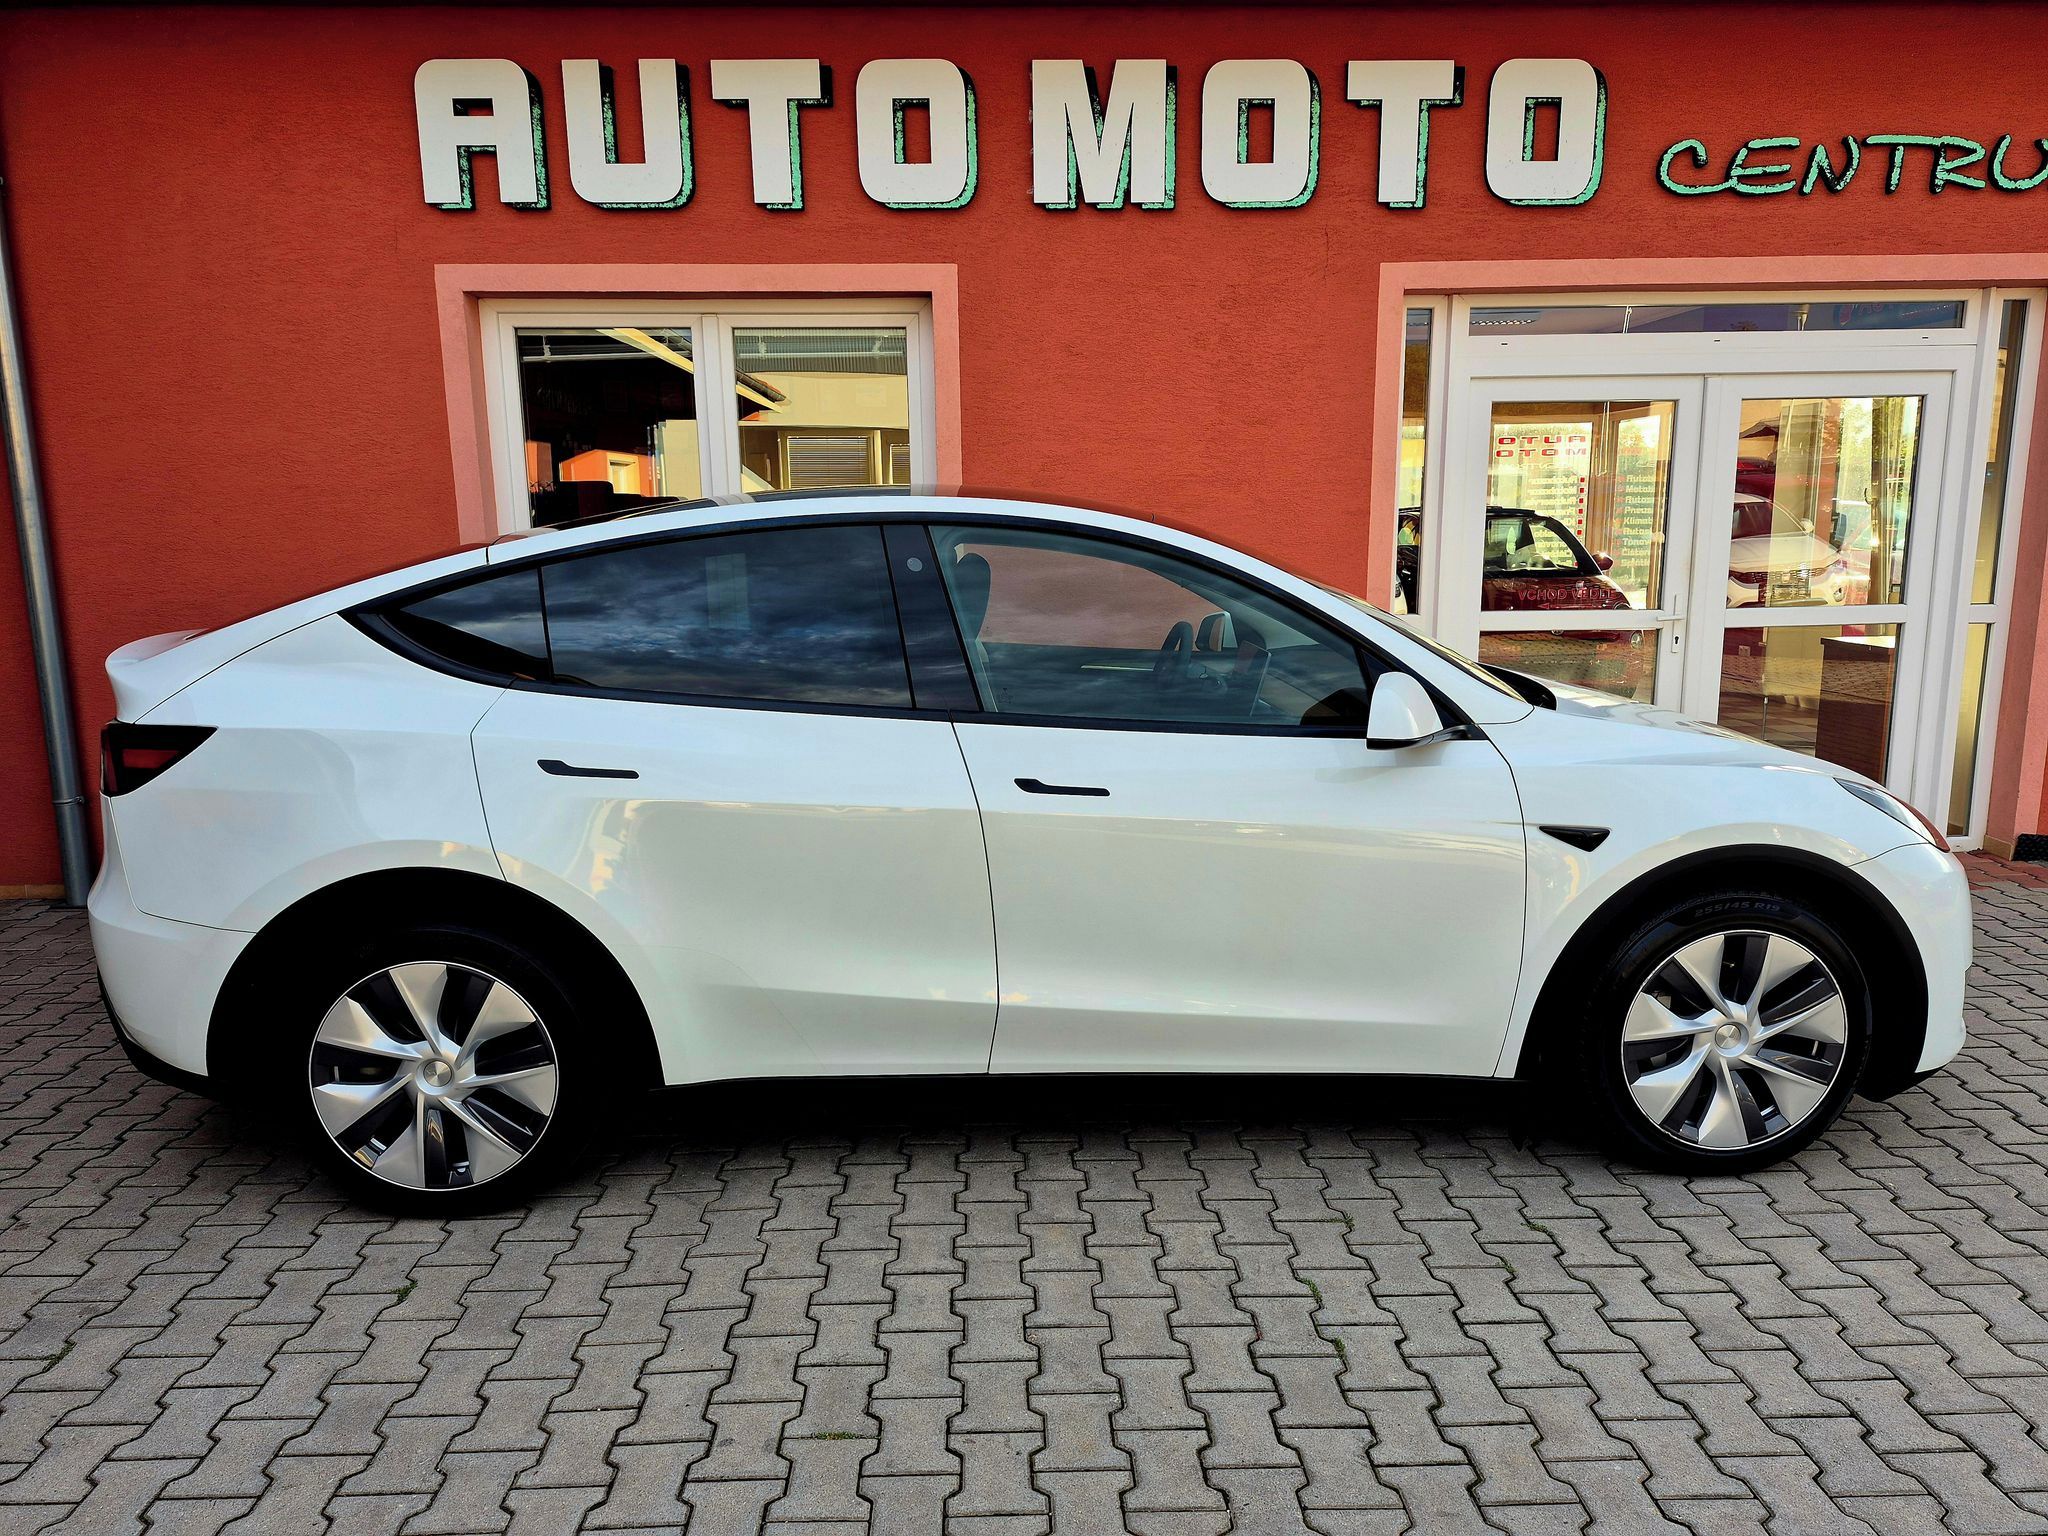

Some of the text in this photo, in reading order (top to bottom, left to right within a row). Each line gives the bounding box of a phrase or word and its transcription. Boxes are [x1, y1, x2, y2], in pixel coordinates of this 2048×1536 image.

[414, 58, 1607, 208] AUTO MOTO
[1656, 134, 2048, 196] CENTRU
[1518, 588, 1617, 600] VCHOD VEDLE
[1694, 900, 1781, 917] 255/45 R19
